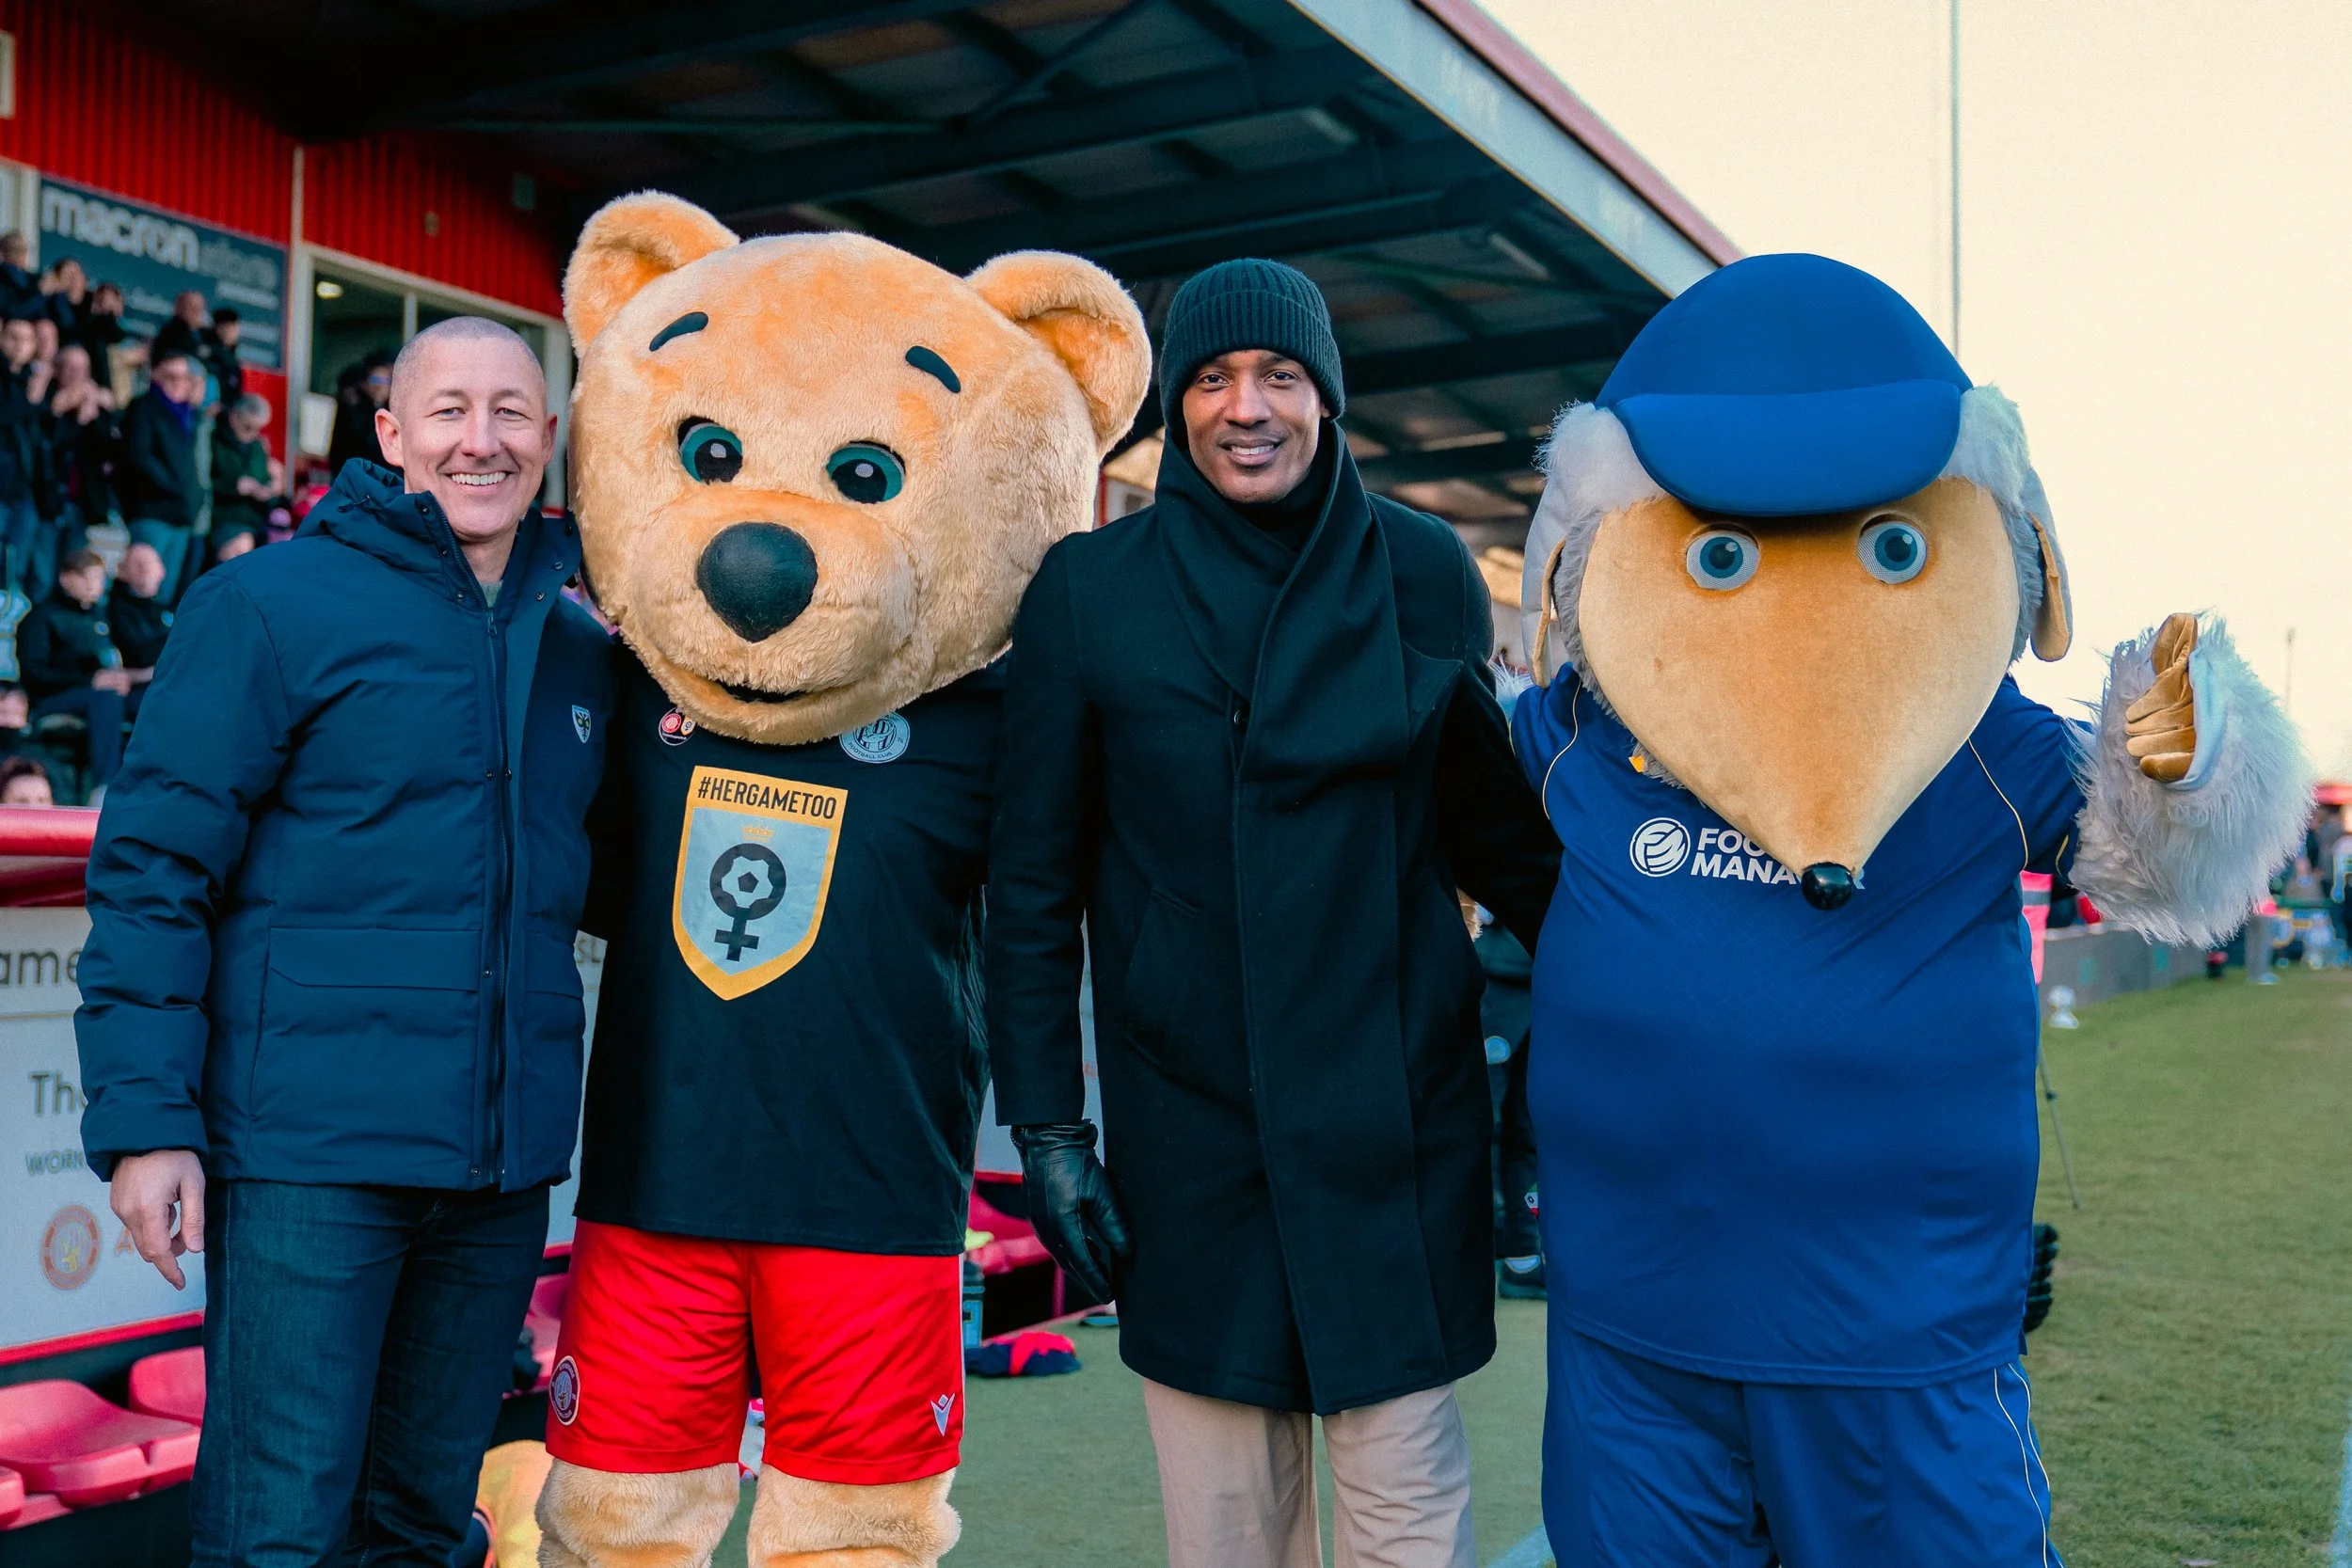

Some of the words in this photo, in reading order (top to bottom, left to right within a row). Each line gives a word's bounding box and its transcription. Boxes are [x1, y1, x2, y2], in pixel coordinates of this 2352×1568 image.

[42, 186, 199, 272] macron
[848, 741, 876, 759] FOOTBALL
[697, 776, 837, 820] #HERGAMETOO
